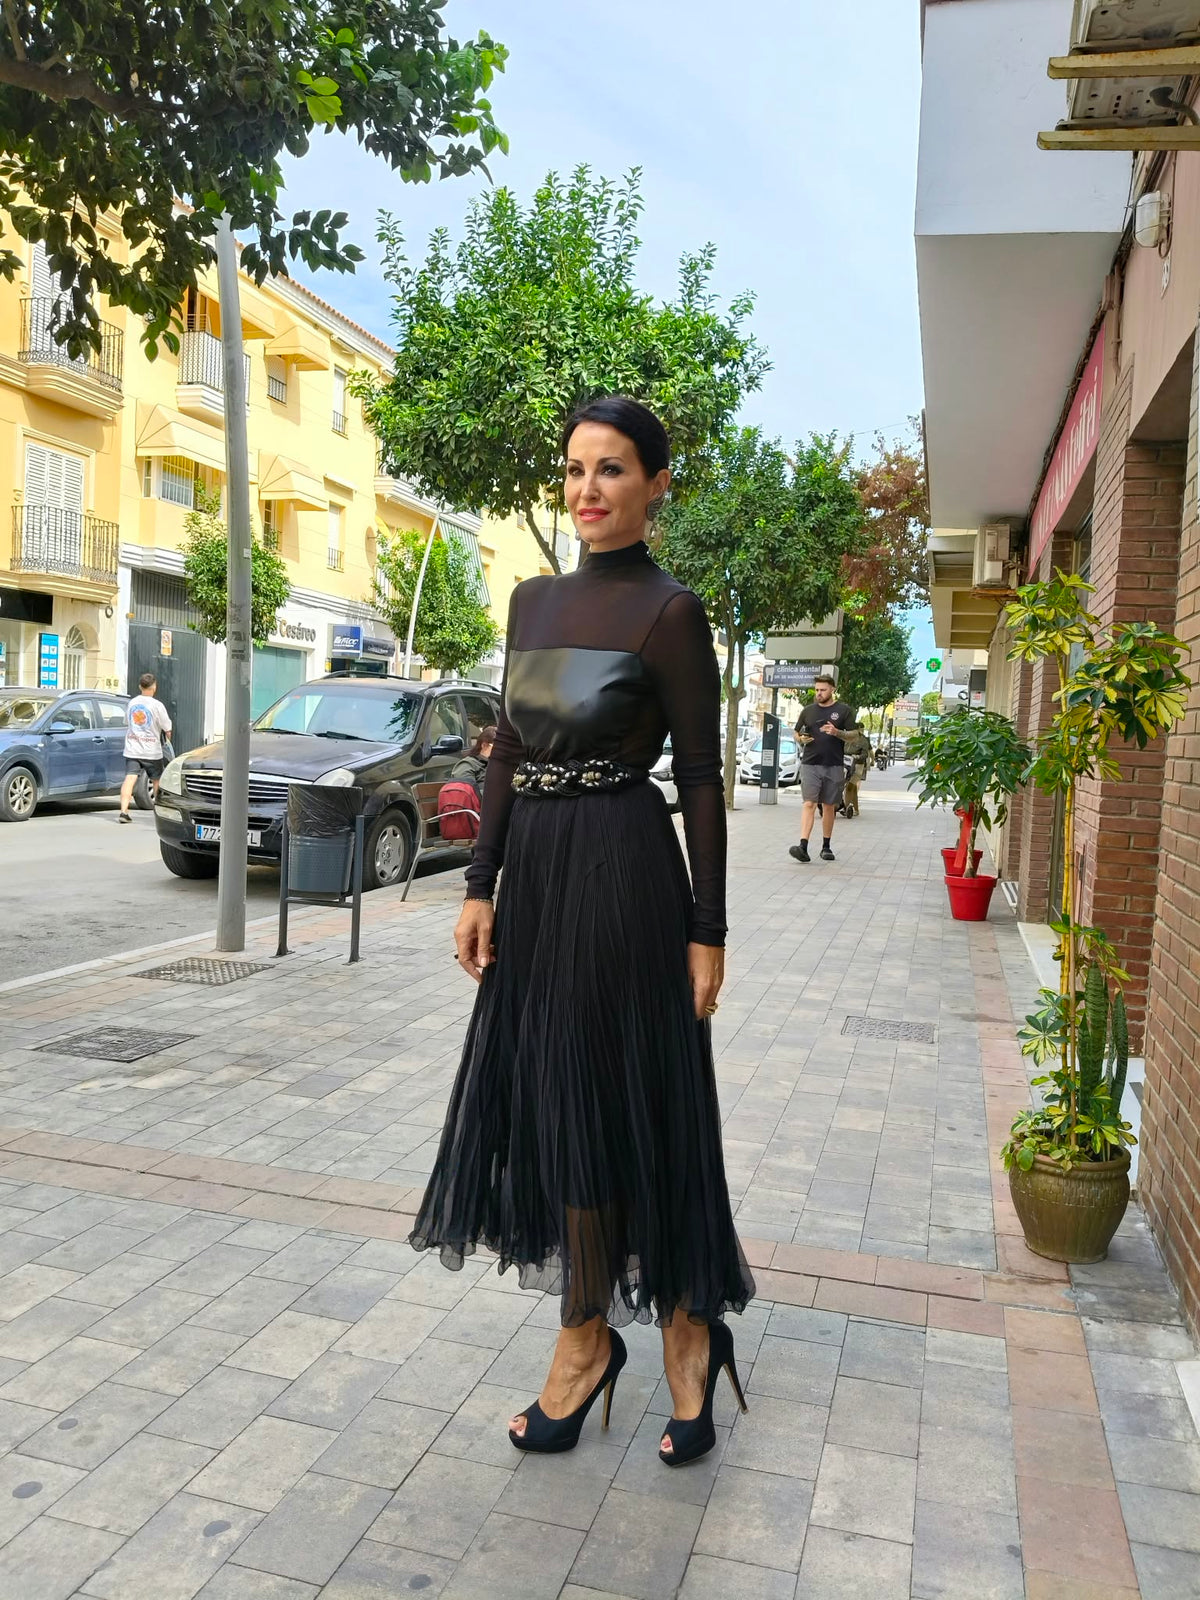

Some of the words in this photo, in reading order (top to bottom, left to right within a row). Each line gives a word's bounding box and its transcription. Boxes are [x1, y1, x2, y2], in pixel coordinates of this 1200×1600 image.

[279, 619, 316, 642] Cesáreo
[799, 665, 821, 673] dental
[767, 724, 774, 732] P
